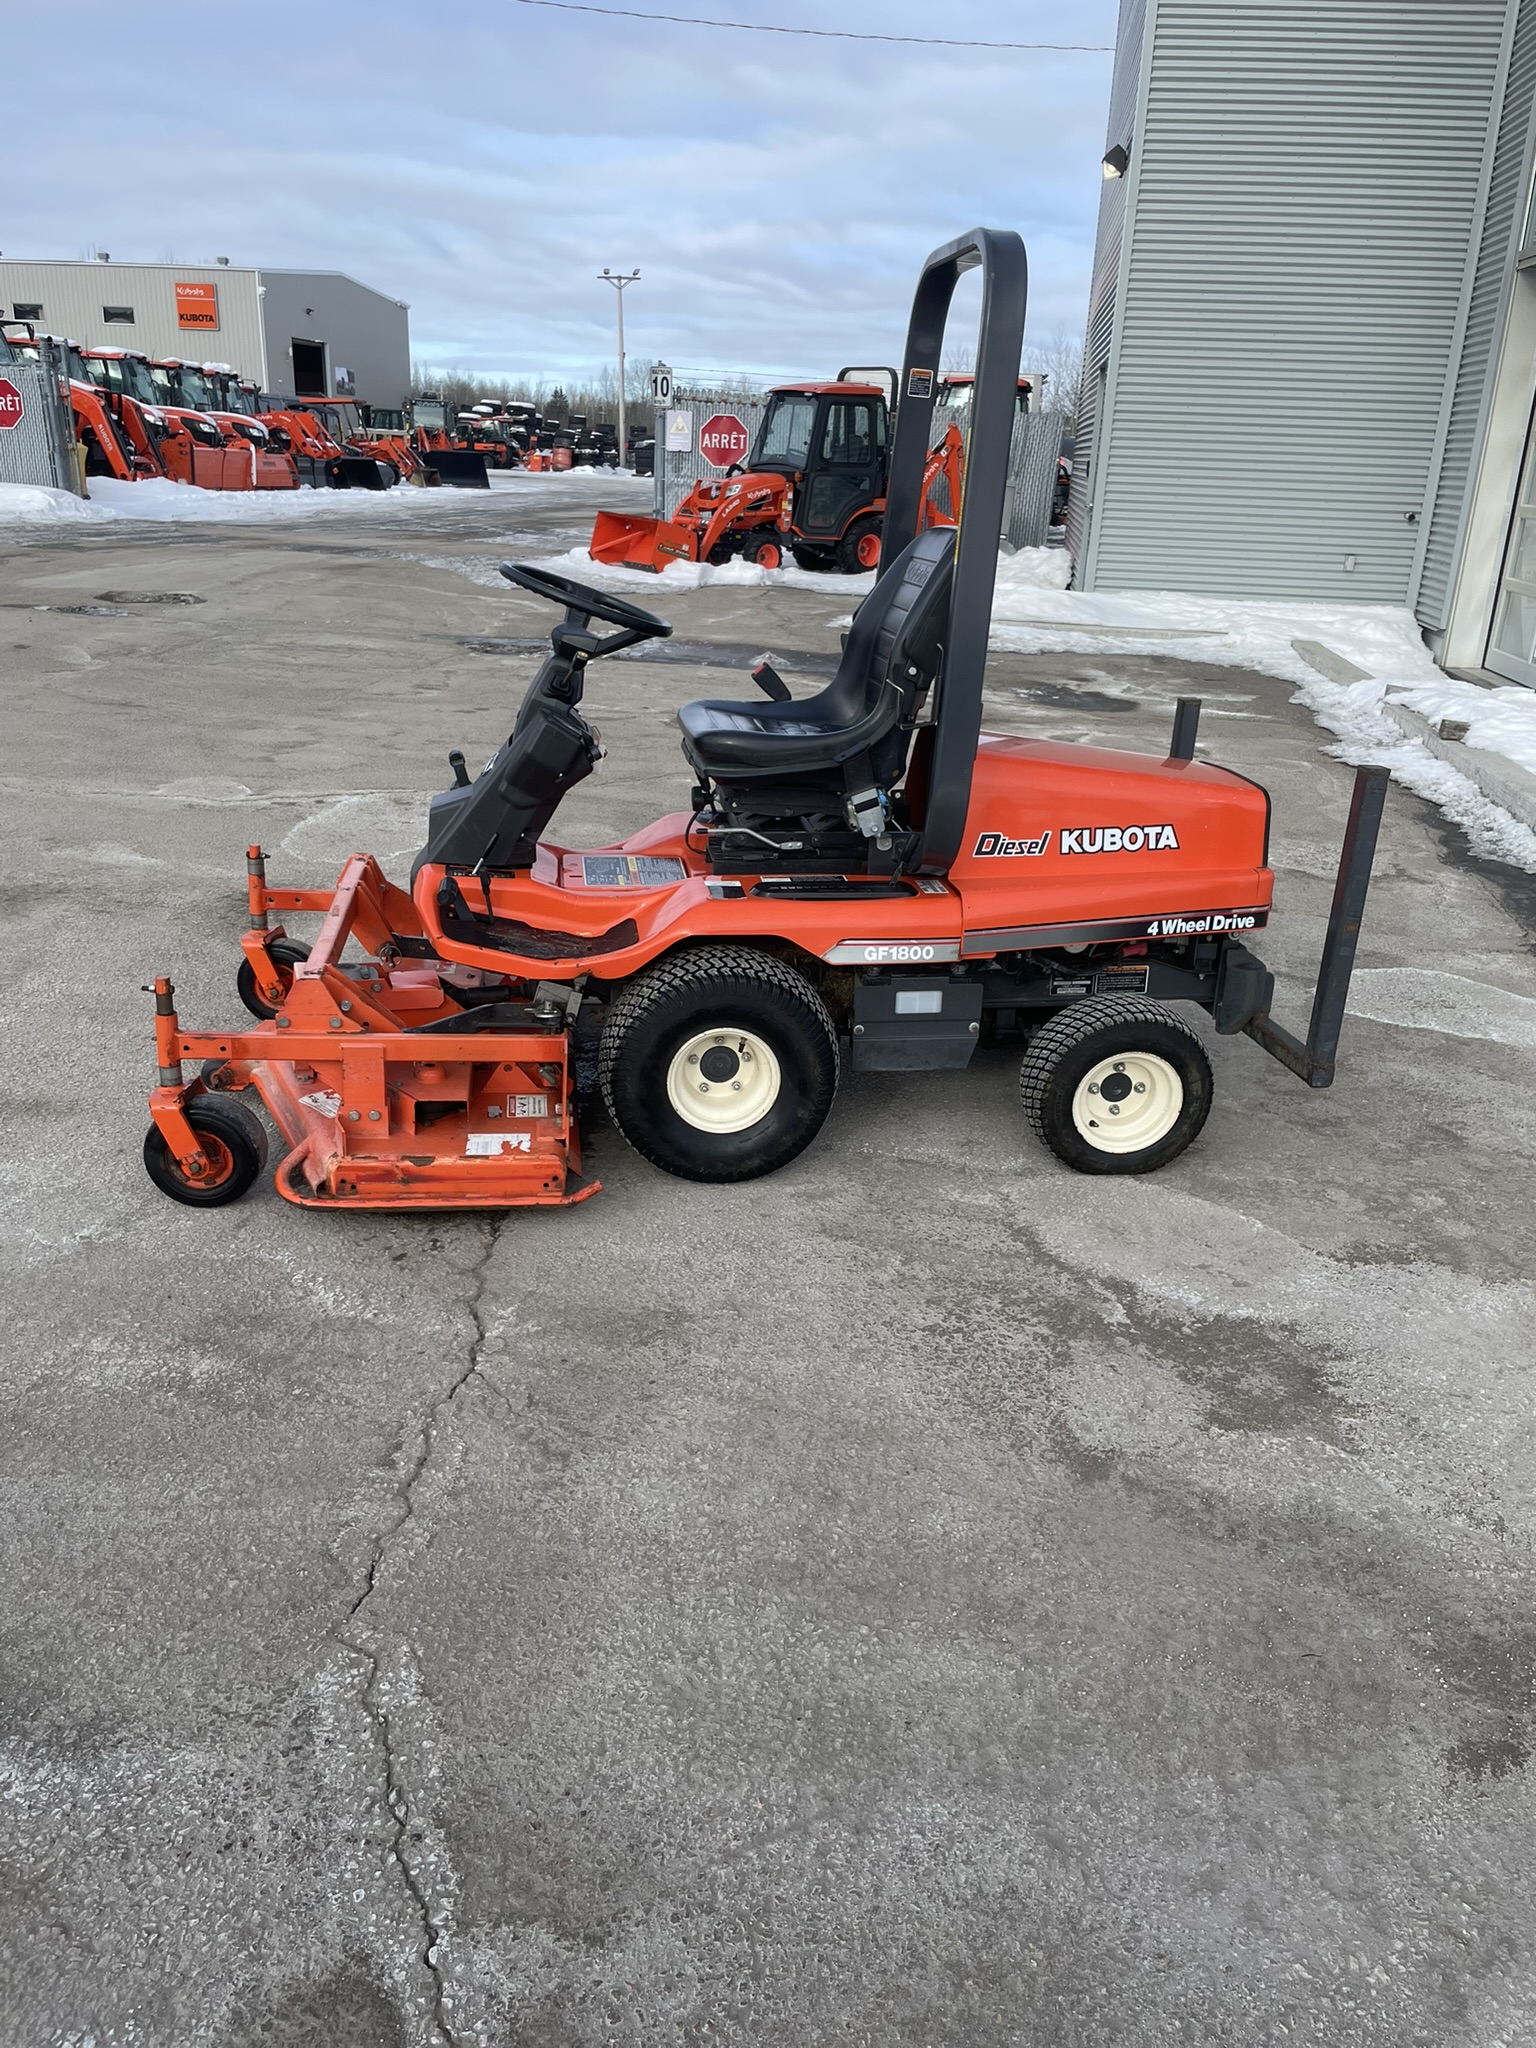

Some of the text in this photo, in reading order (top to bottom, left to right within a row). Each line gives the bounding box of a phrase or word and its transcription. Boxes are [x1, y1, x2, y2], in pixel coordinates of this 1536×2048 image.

[179, 313, 215, 322] KUBOTA
[652, 376, 669, 397] 10
[98, 424, 113, 451] KUBOTA
[702, 431, 746, 450] ARRÊT
[923, 462, 939, 483] ubota
[747, 488, 771, 499] Kubota
[973, 825, 1180, 857] Diesel KUBOTA
[1147, 914, 1255, 936] 4 Wheel Drive
[864, 945, 934, 961] GF1800
